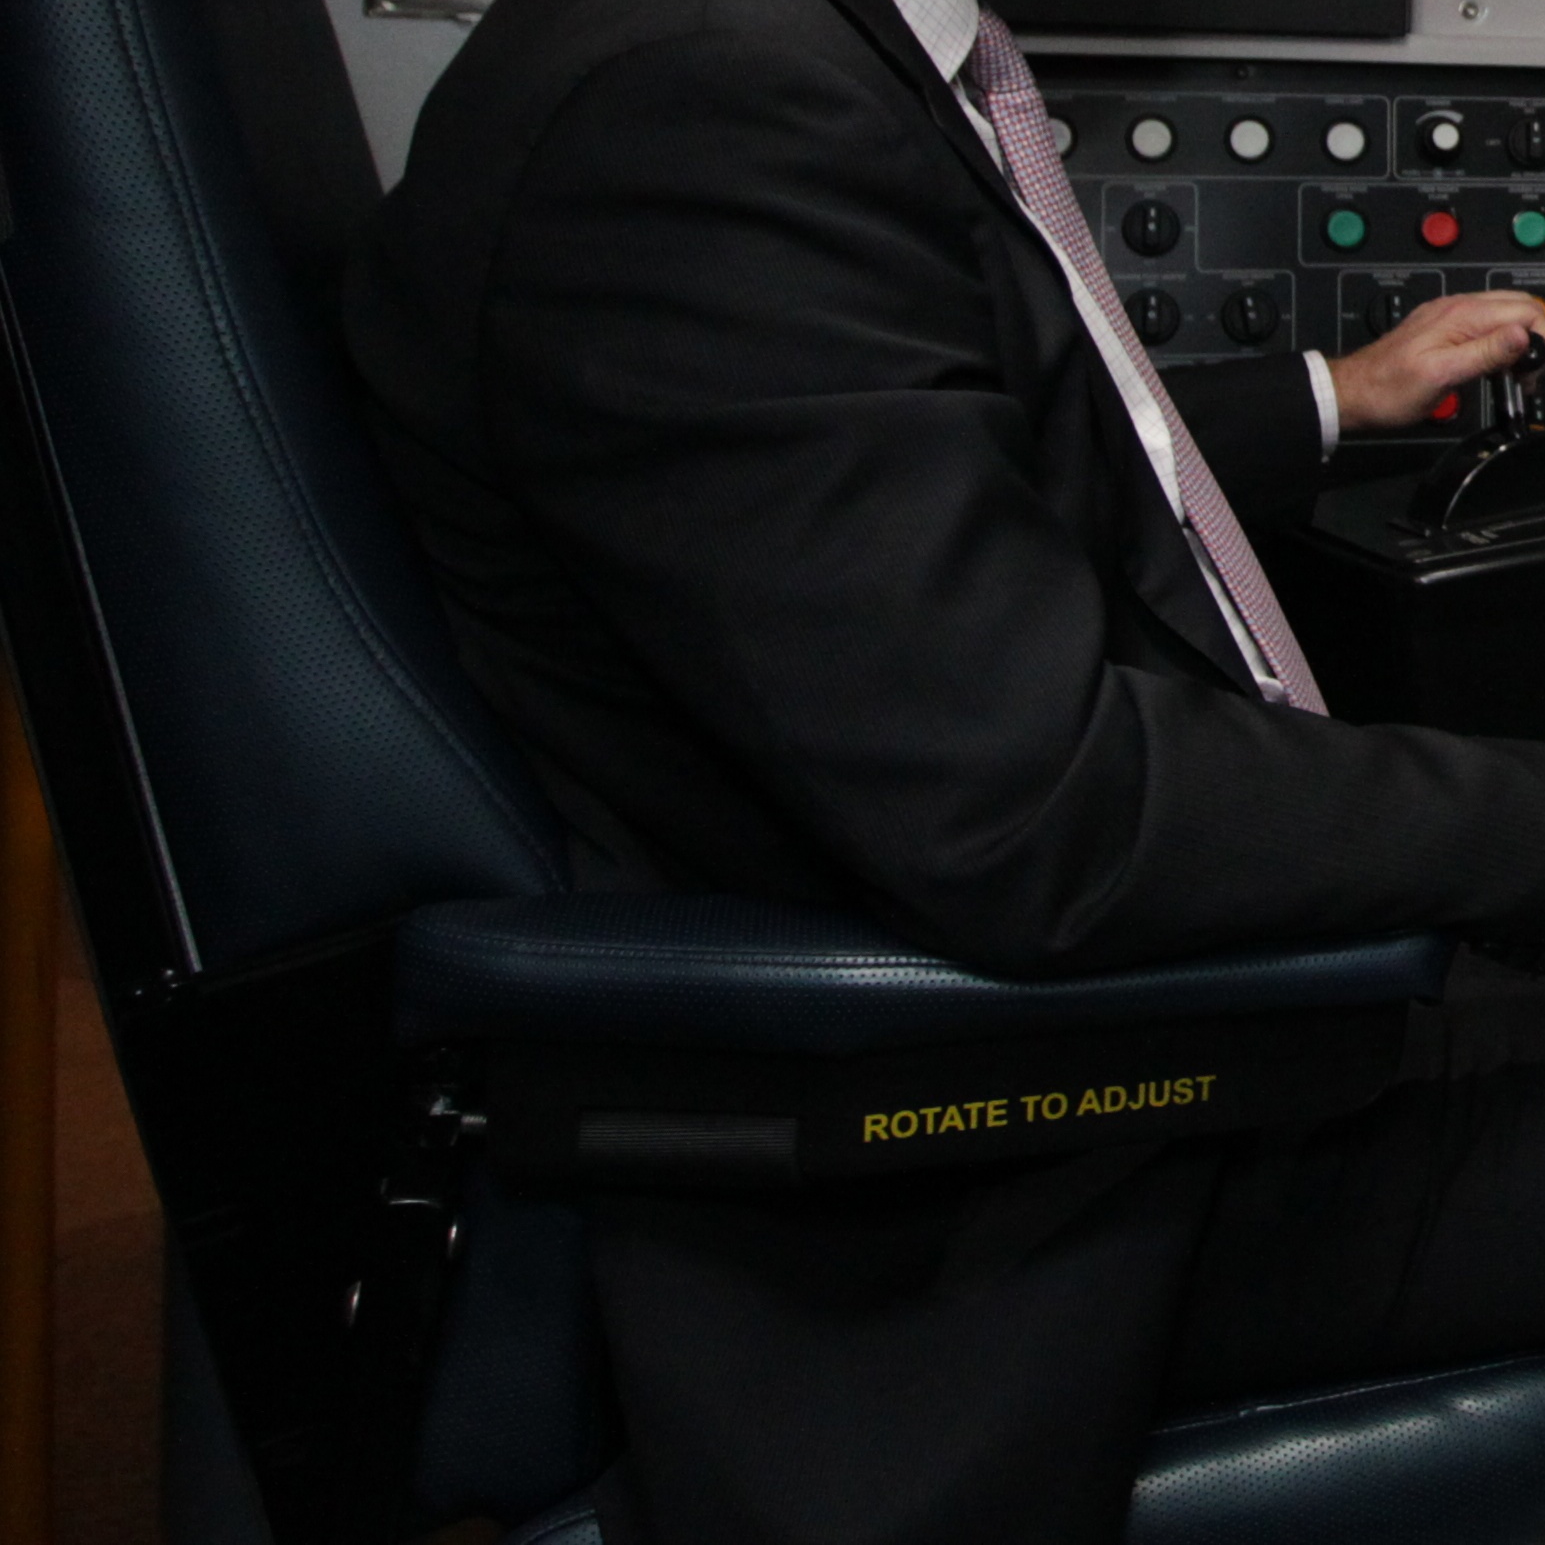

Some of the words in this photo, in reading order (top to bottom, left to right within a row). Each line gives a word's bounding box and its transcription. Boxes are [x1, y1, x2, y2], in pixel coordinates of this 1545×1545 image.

[863, 1098, 1009, 1142] ROTATE
[1020, 1093, 1068, 1122] TO
[1076, 1075, 1217, 1116] ADJUST
